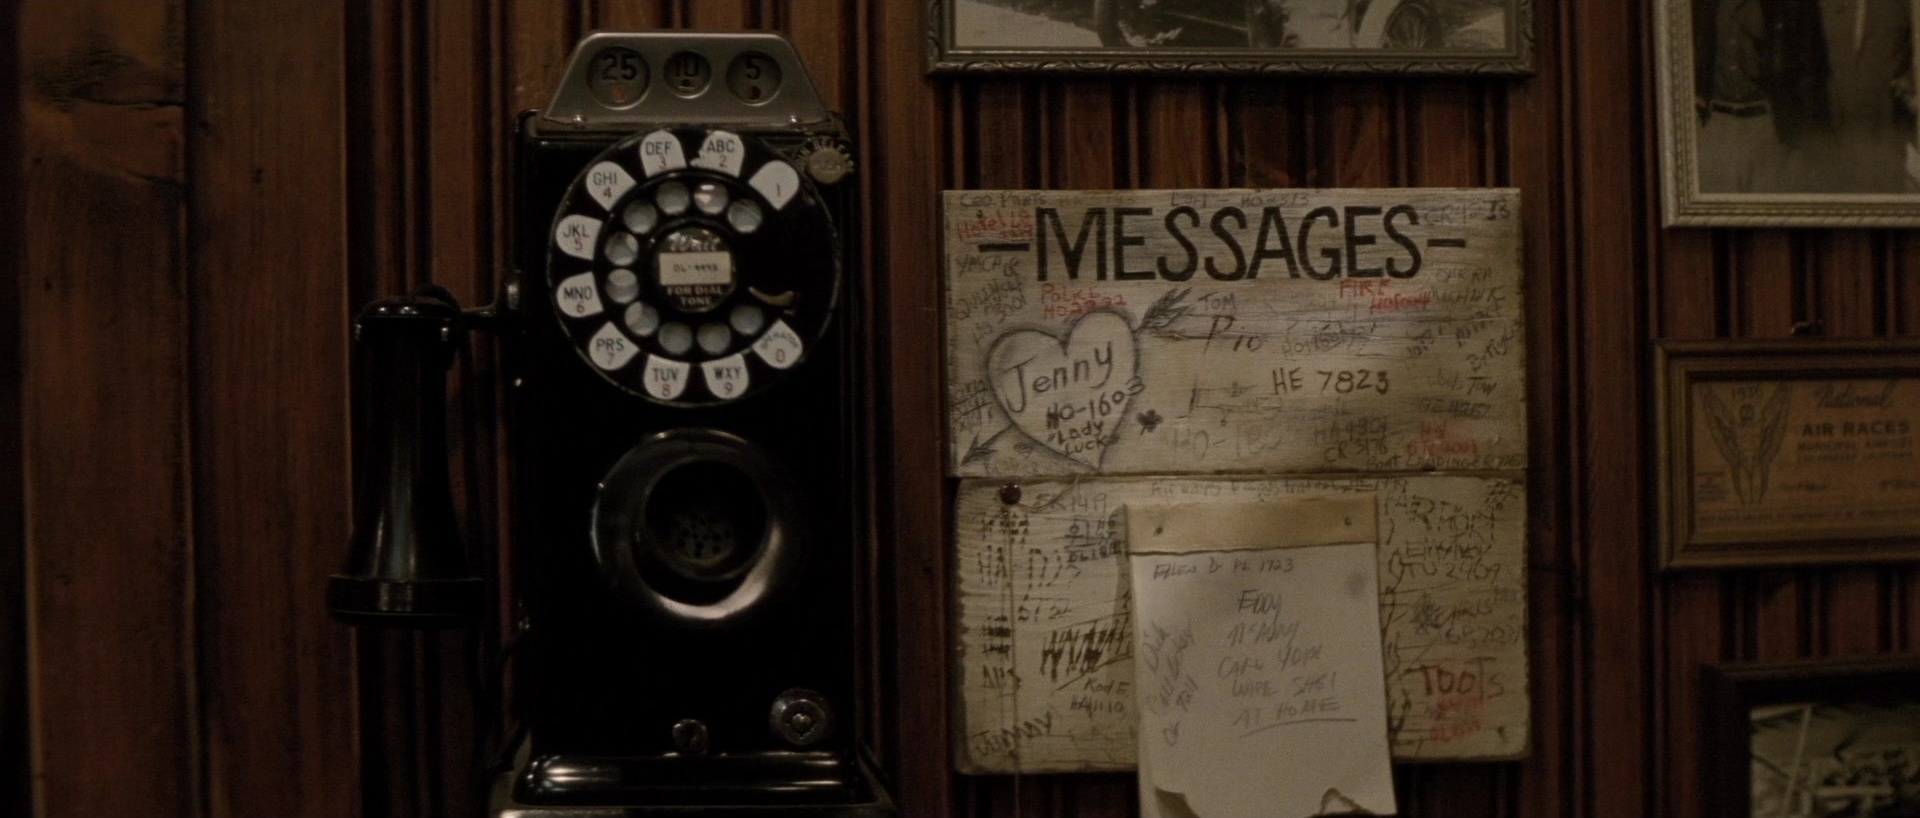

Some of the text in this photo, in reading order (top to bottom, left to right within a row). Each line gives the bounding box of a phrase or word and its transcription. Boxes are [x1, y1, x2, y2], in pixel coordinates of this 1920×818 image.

[602, 54, 637, 80] 25
[673, 55, 699, 77] 10
[746, 55, 761, 79] 5
[646, 141, 672, 155] DEF
[707, 139, 735, 154] ABC
[658, 155, 667, 169] 3
[719, 155, 728, 168] 2
[592, 172, 618, 187] GHI
[603, 185, 612, 199] 4
[563, 223, 589, 238] JKL
[574, 238, 583, 251] 5
[564, 286, 593, 301] MNO
[666, 285, 723, 297] FOR DIAL
[576, 301, 585, 314] 6
[596, 338, 625, 352] PRS
[606, 351, 615, 366] 7
[653, 368, 679, 383] TUV
[714, 366, 742, 381] WXY
[1003, 341, 1113, 413] Jenny
[724, 381, 733, 394] 9
[1272, 367, 1303, 396] HE
[1316, 367, 1390, 395] 7823
[661, 383, 671, 397] 8
[1802, 419, 1911, 438] AIR RACES
[1402, 656, 1506, 705] TOOTS
